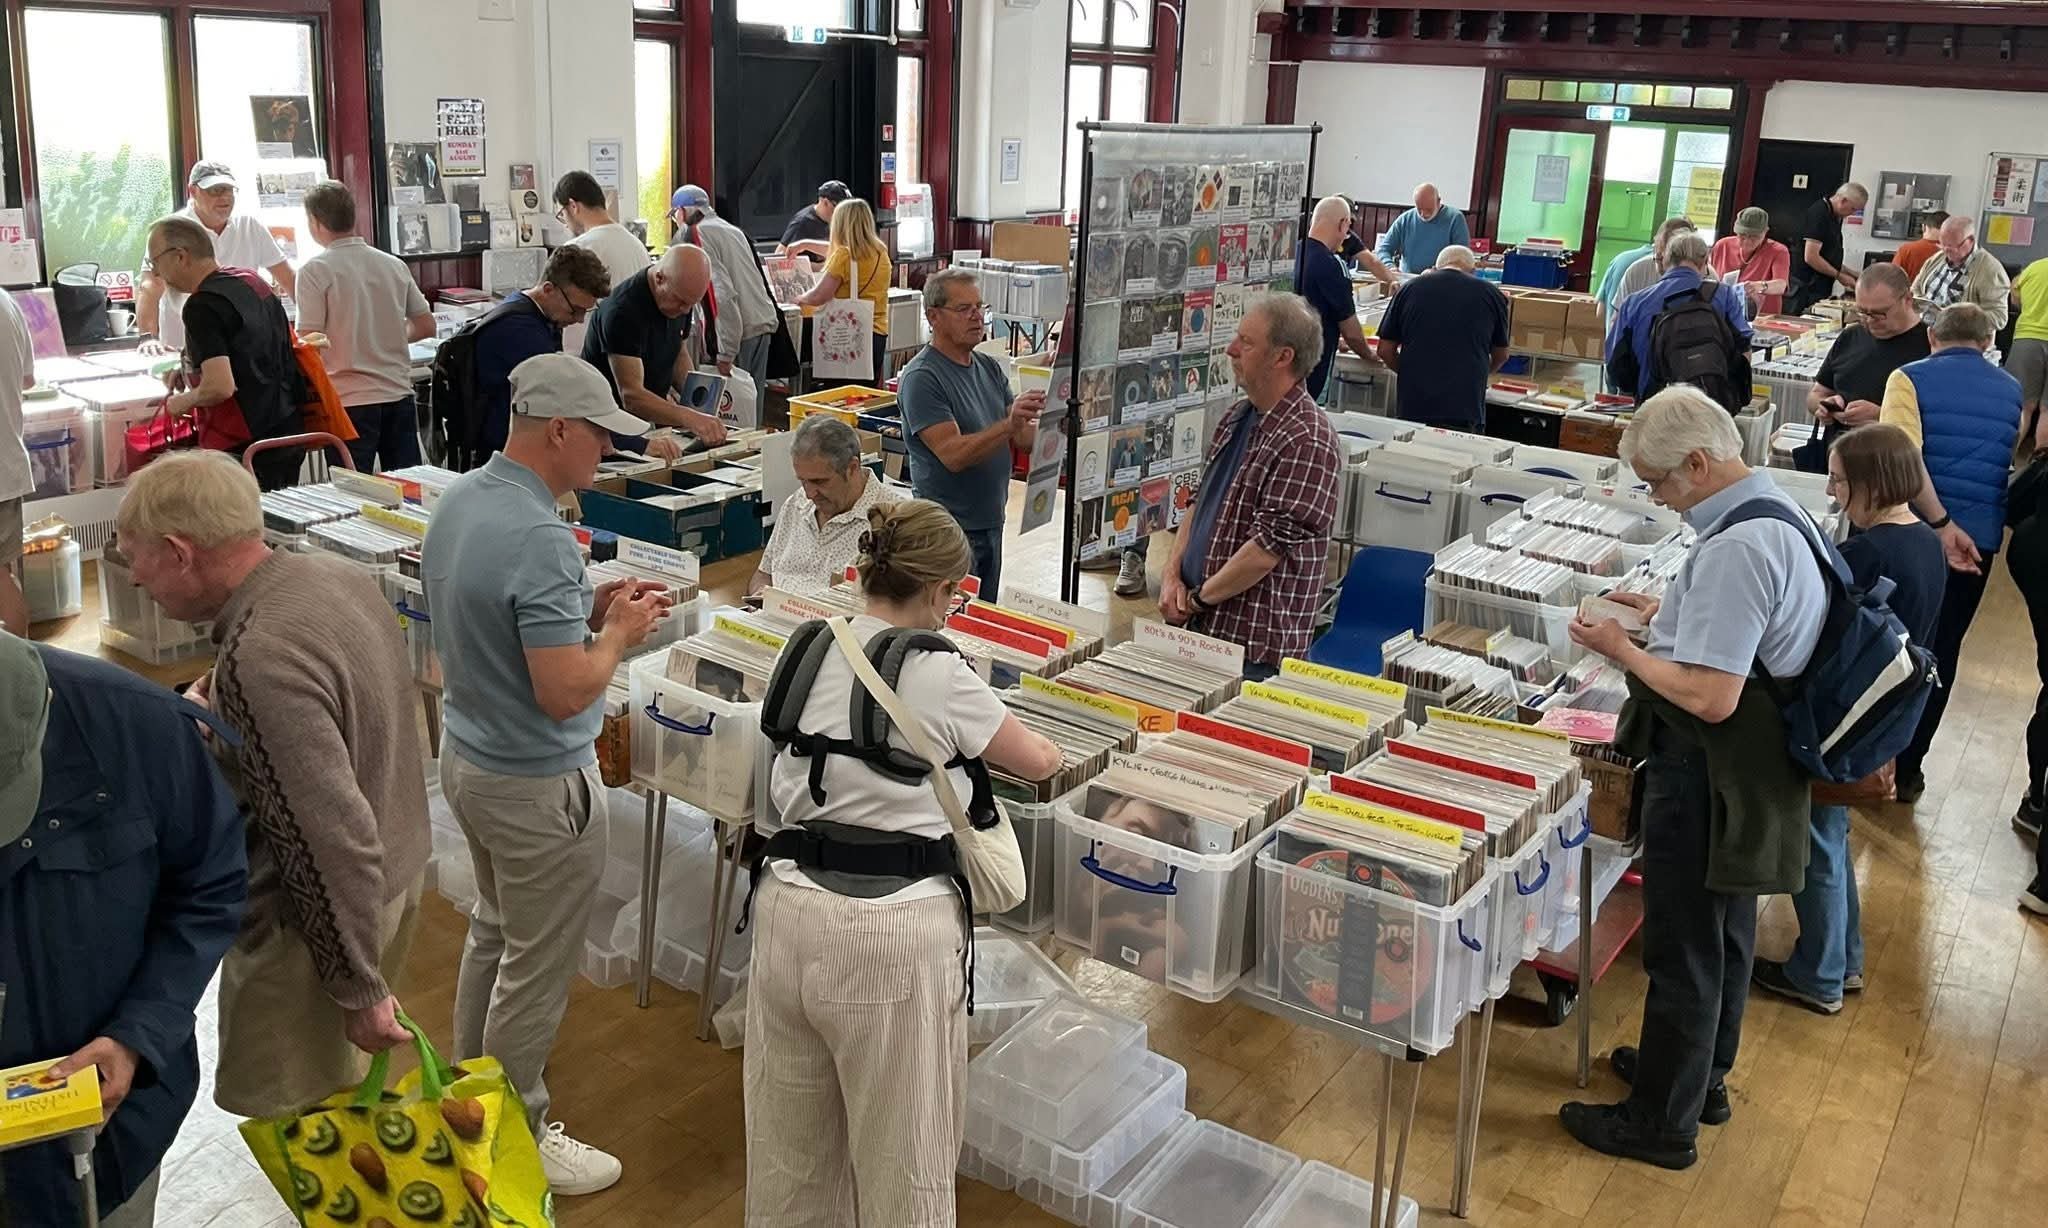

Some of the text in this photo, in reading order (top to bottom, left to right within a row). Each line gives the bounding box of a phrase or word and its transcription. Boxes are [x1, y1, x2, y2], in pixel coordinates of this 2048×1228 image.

[446, 125, 479, 136] HERE
[1174, 469, 1199, 486] CBS
[1112, 490, 1135, 506] RCA
[1167, 631, 1176, 641] &
[1178, 633, 1197, 647] 90's
[1199, 639, 1223, 654] Rock
[1224, 648, 1233, 656] &
[1178, 646, 1196, 659] Pop
[1112, 755, 1142, 771] KYLIE
[1150, 764, 1178, 780] GEORGE
[1306, 906, 1344, 942] Nu
